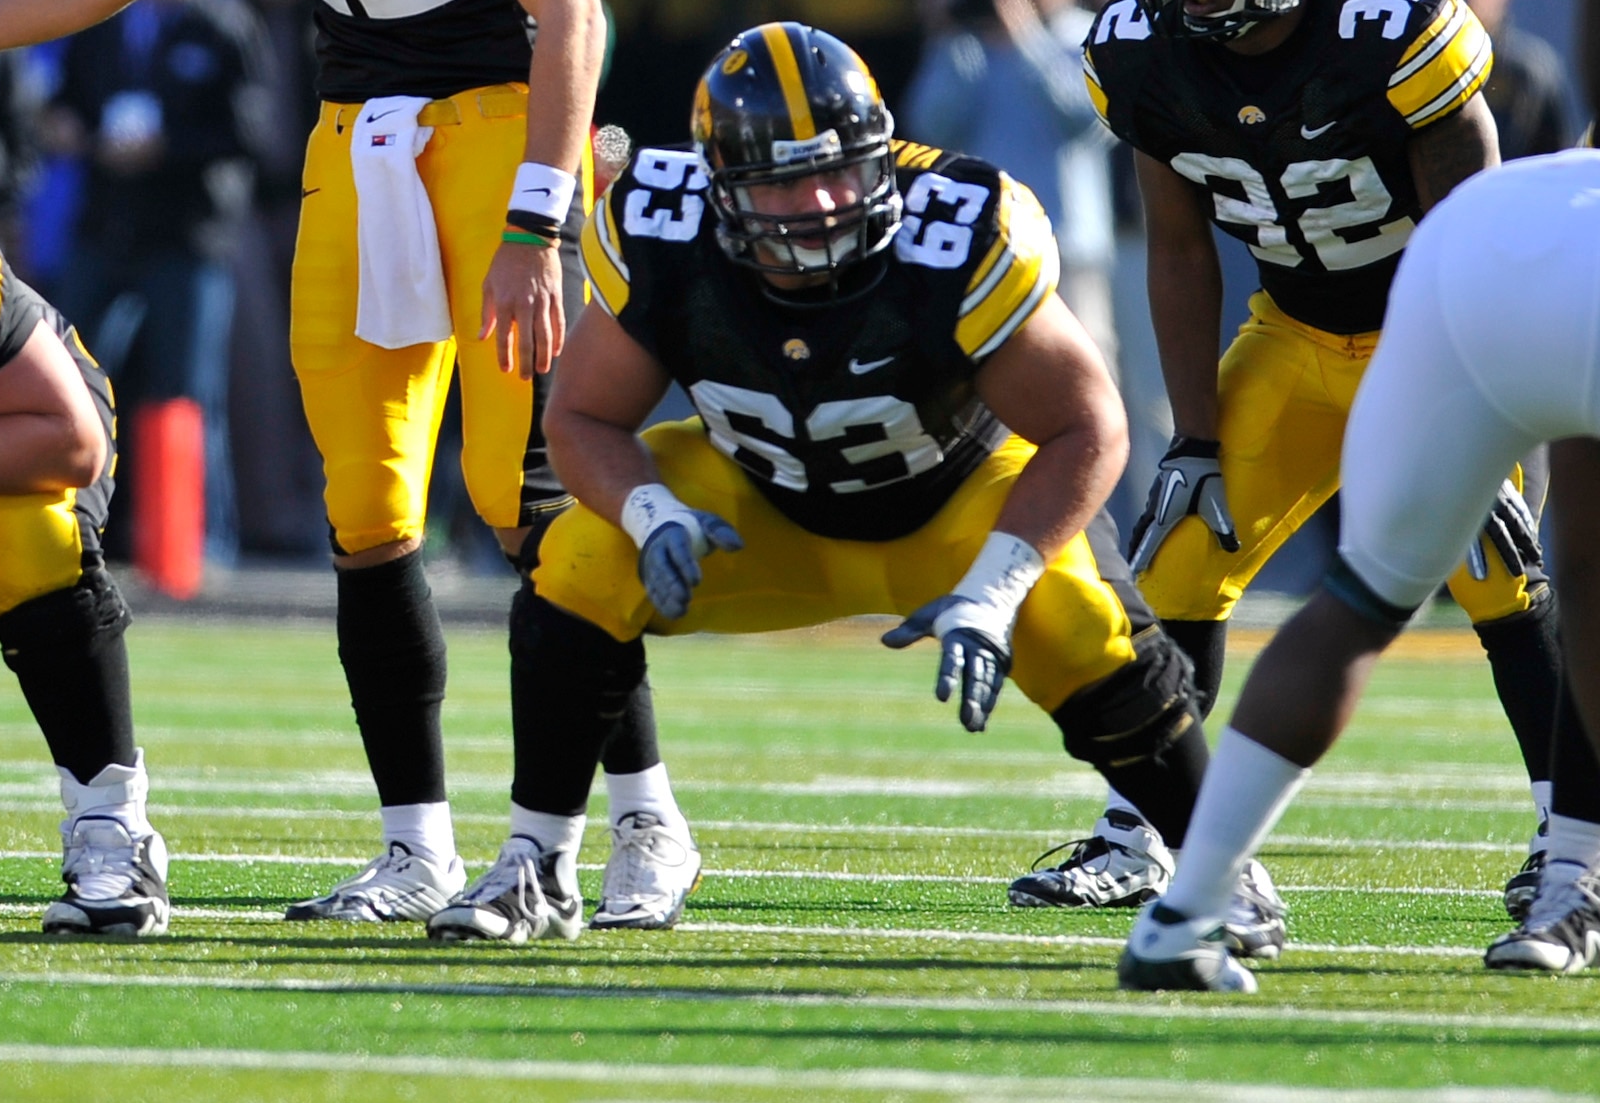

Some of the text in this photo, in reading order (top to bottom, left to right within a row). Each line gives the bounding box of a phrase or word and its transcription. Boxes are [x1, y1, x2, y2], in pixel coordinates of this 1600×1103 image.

[623, 148, 709, 243] 63
[896, 172, 990, 269] 63
[1171, 152, 1415, 271] 32
[691, 380, 943, 494] 63
